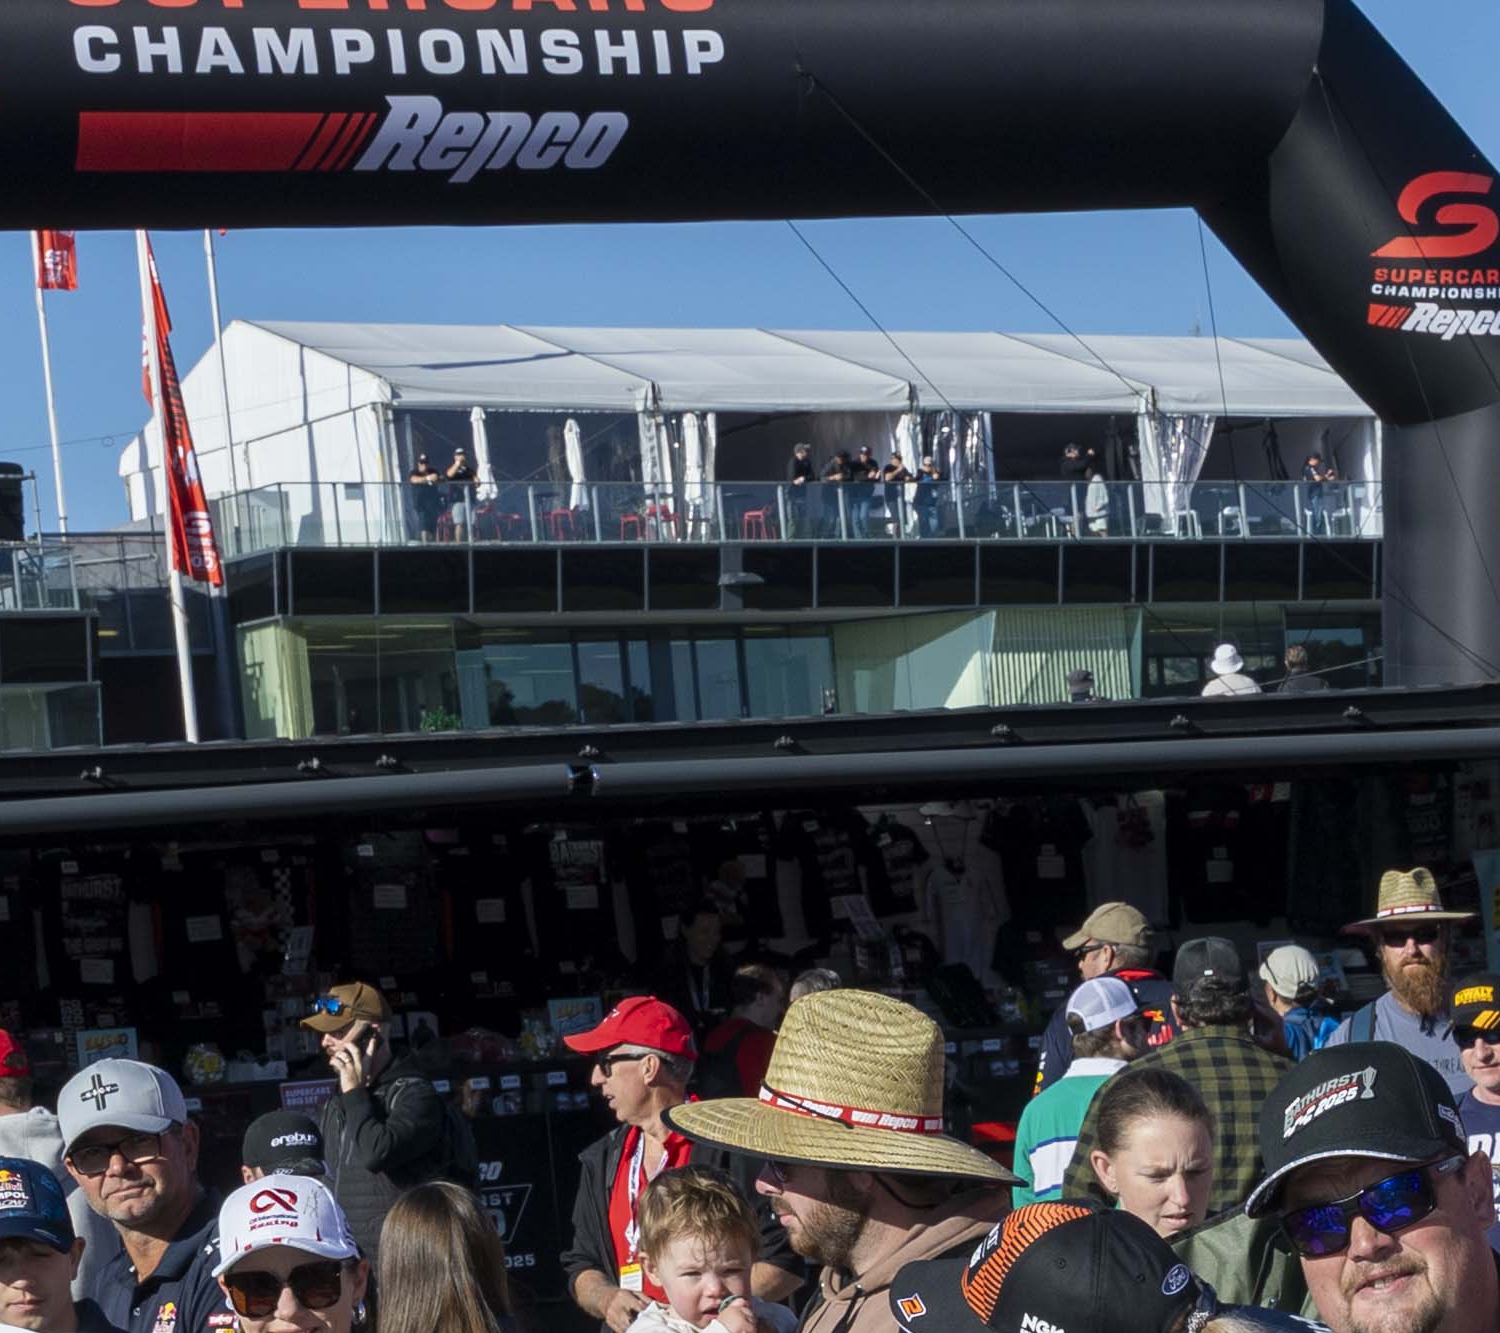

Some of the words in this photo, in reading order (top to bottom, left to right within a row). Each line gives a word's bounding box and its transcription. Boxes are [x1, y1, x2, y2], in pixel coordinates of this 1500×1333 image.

[73, 23, 726, 76] CHAMPIONSHIP
[355, 95, 628, 184] Repco
[1283, 1070, 1363, 1130] BATHURST
[1313, 1086, 1358, 1118] 2025
